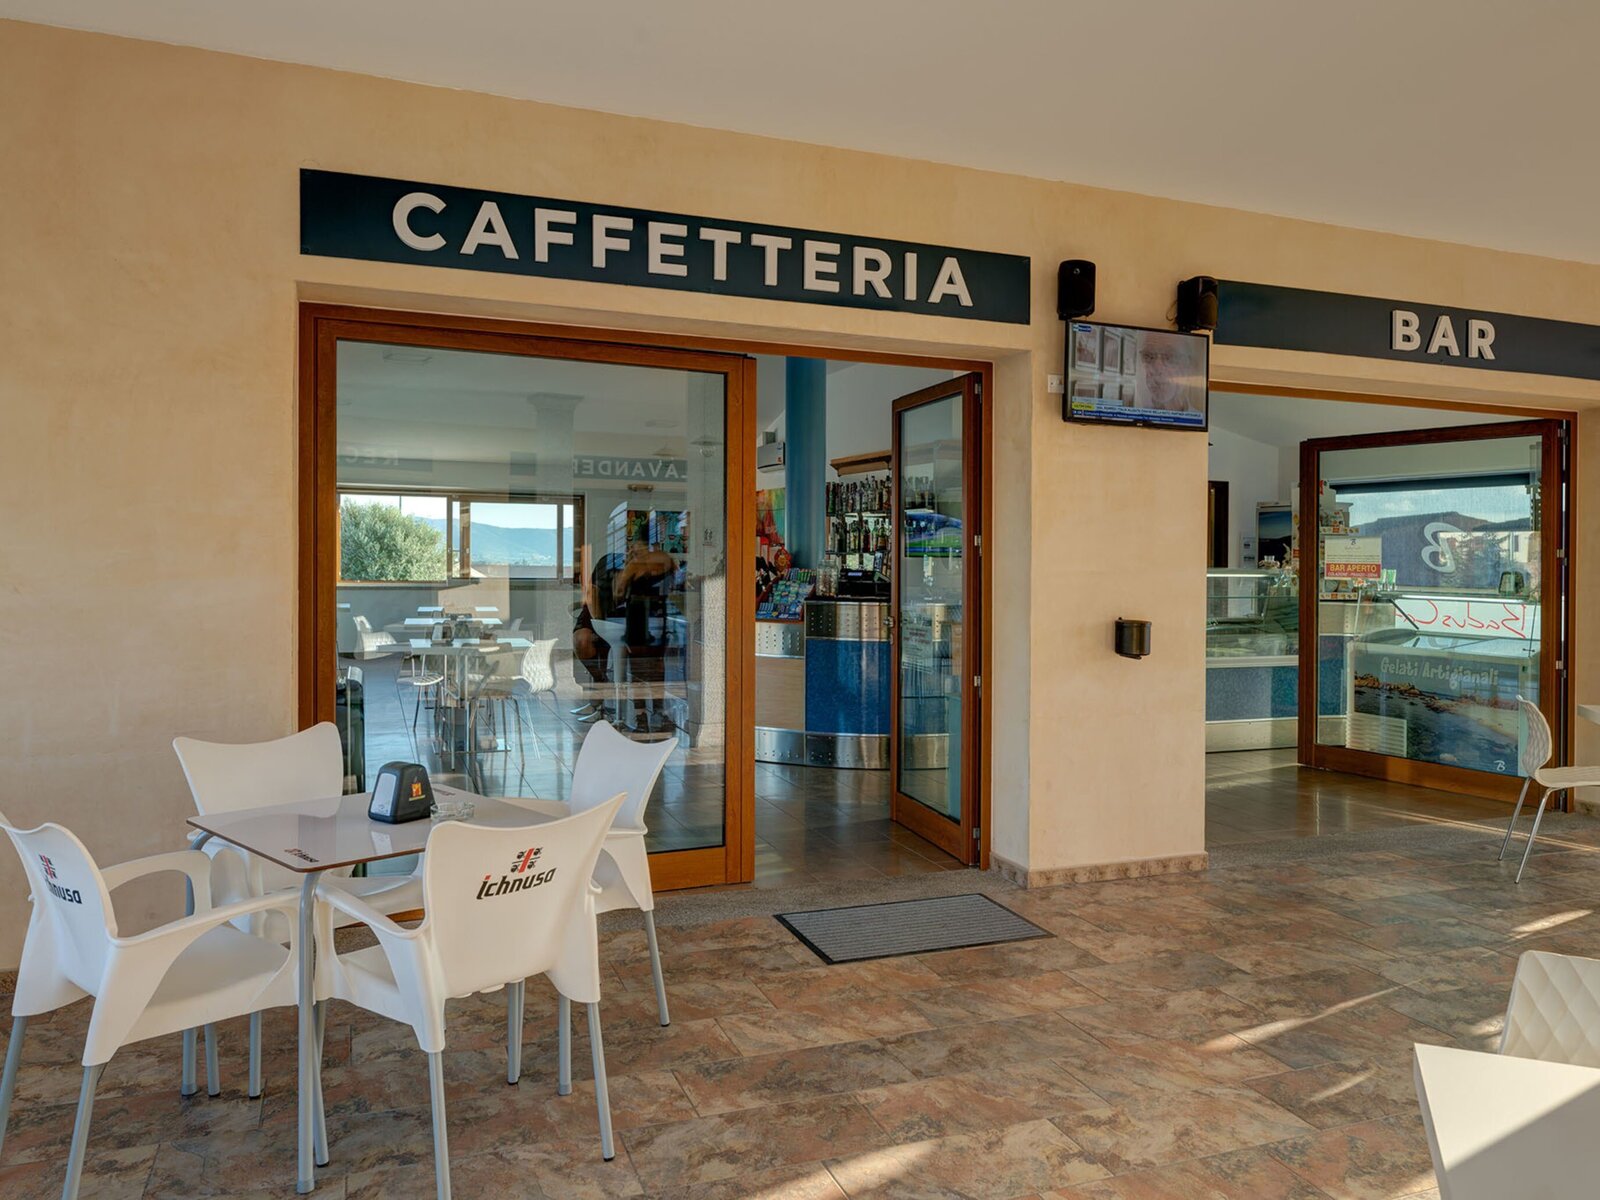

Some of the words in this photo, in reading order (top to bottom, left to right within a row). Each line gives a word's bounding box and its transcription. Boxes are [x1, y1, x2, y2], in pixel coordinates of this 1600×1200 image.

[393, 192, 973, 307] CAFFETTERIA
[1391, 309, 1496, 360] BAR
[1347, 564, 1377, 572] APERTO
[1380, 656, 1418, 677] Gelati
[1422, 662, 1498, 690] Artigianali
[476, 867, 557, 900] ichnusa
